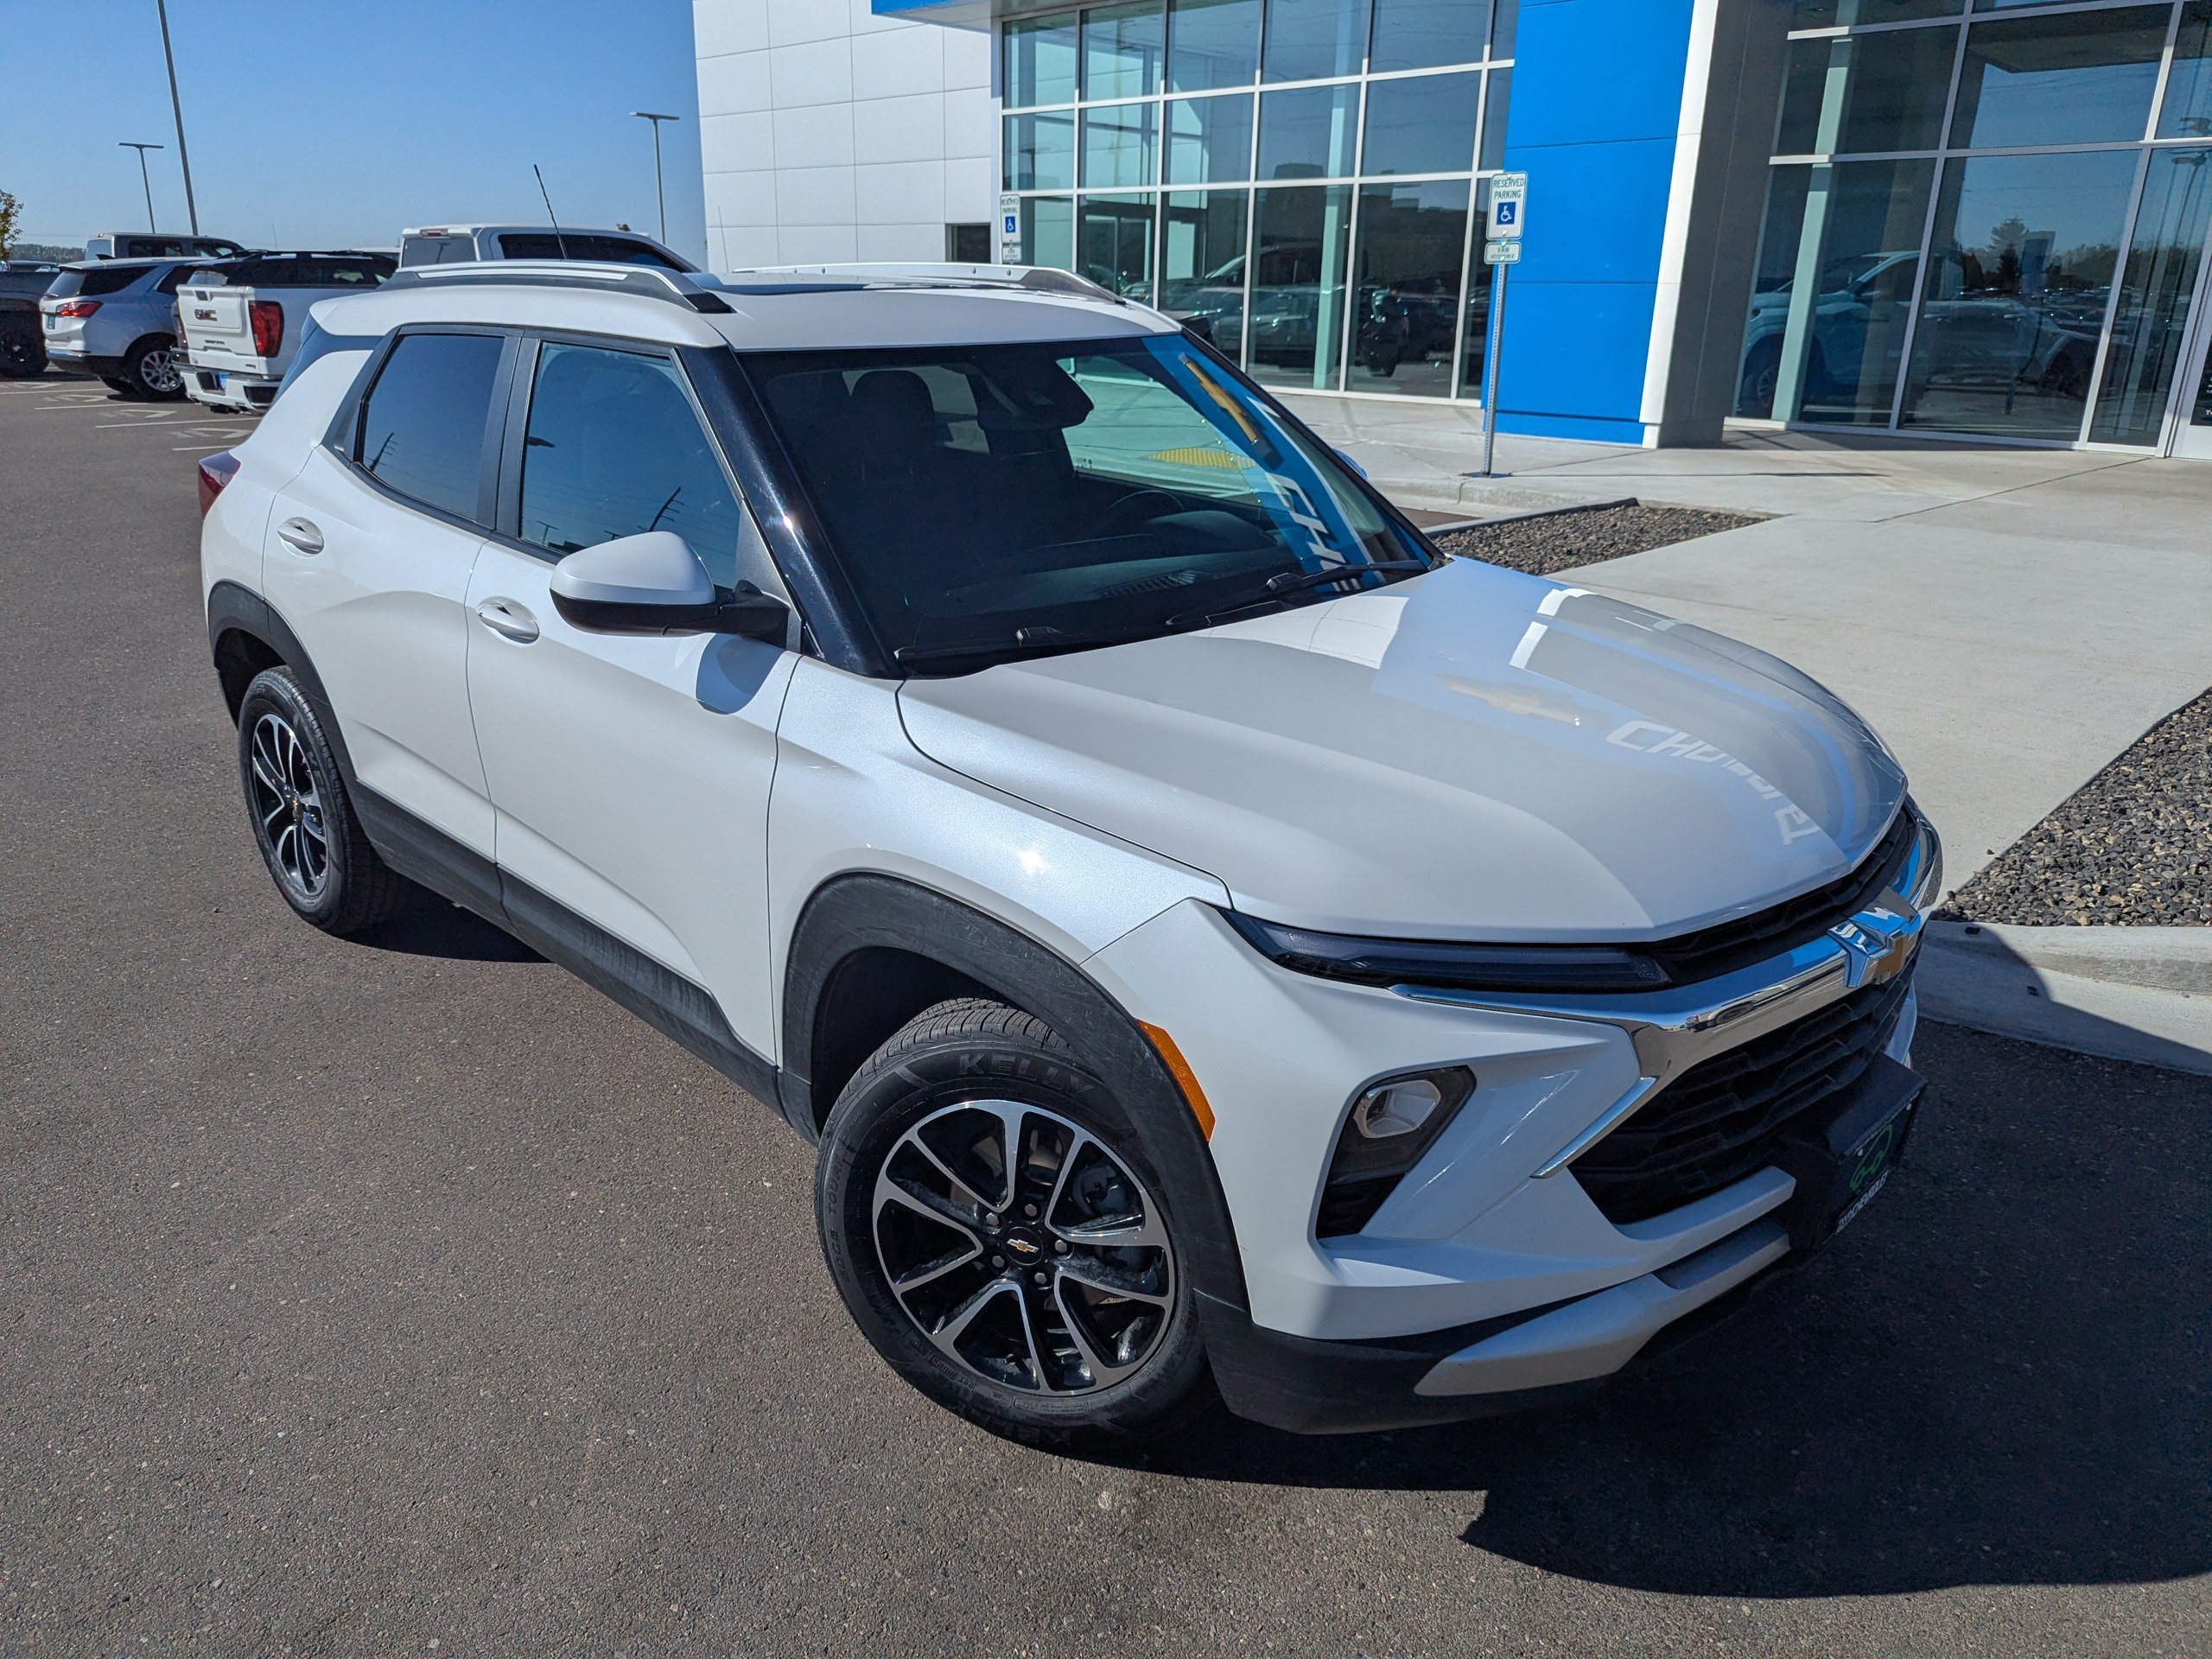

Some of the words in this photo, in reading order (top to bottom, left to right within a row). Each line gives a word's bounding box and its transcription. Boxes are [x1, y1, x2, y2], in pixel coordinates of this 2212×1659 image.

[1493, 178, 1524, 188] RESERVED
[1493, 190, 1522, 200] PARKING
[194, 308, 218, 321] GMC
[957, 1052, 1095, 1098] KELLY
